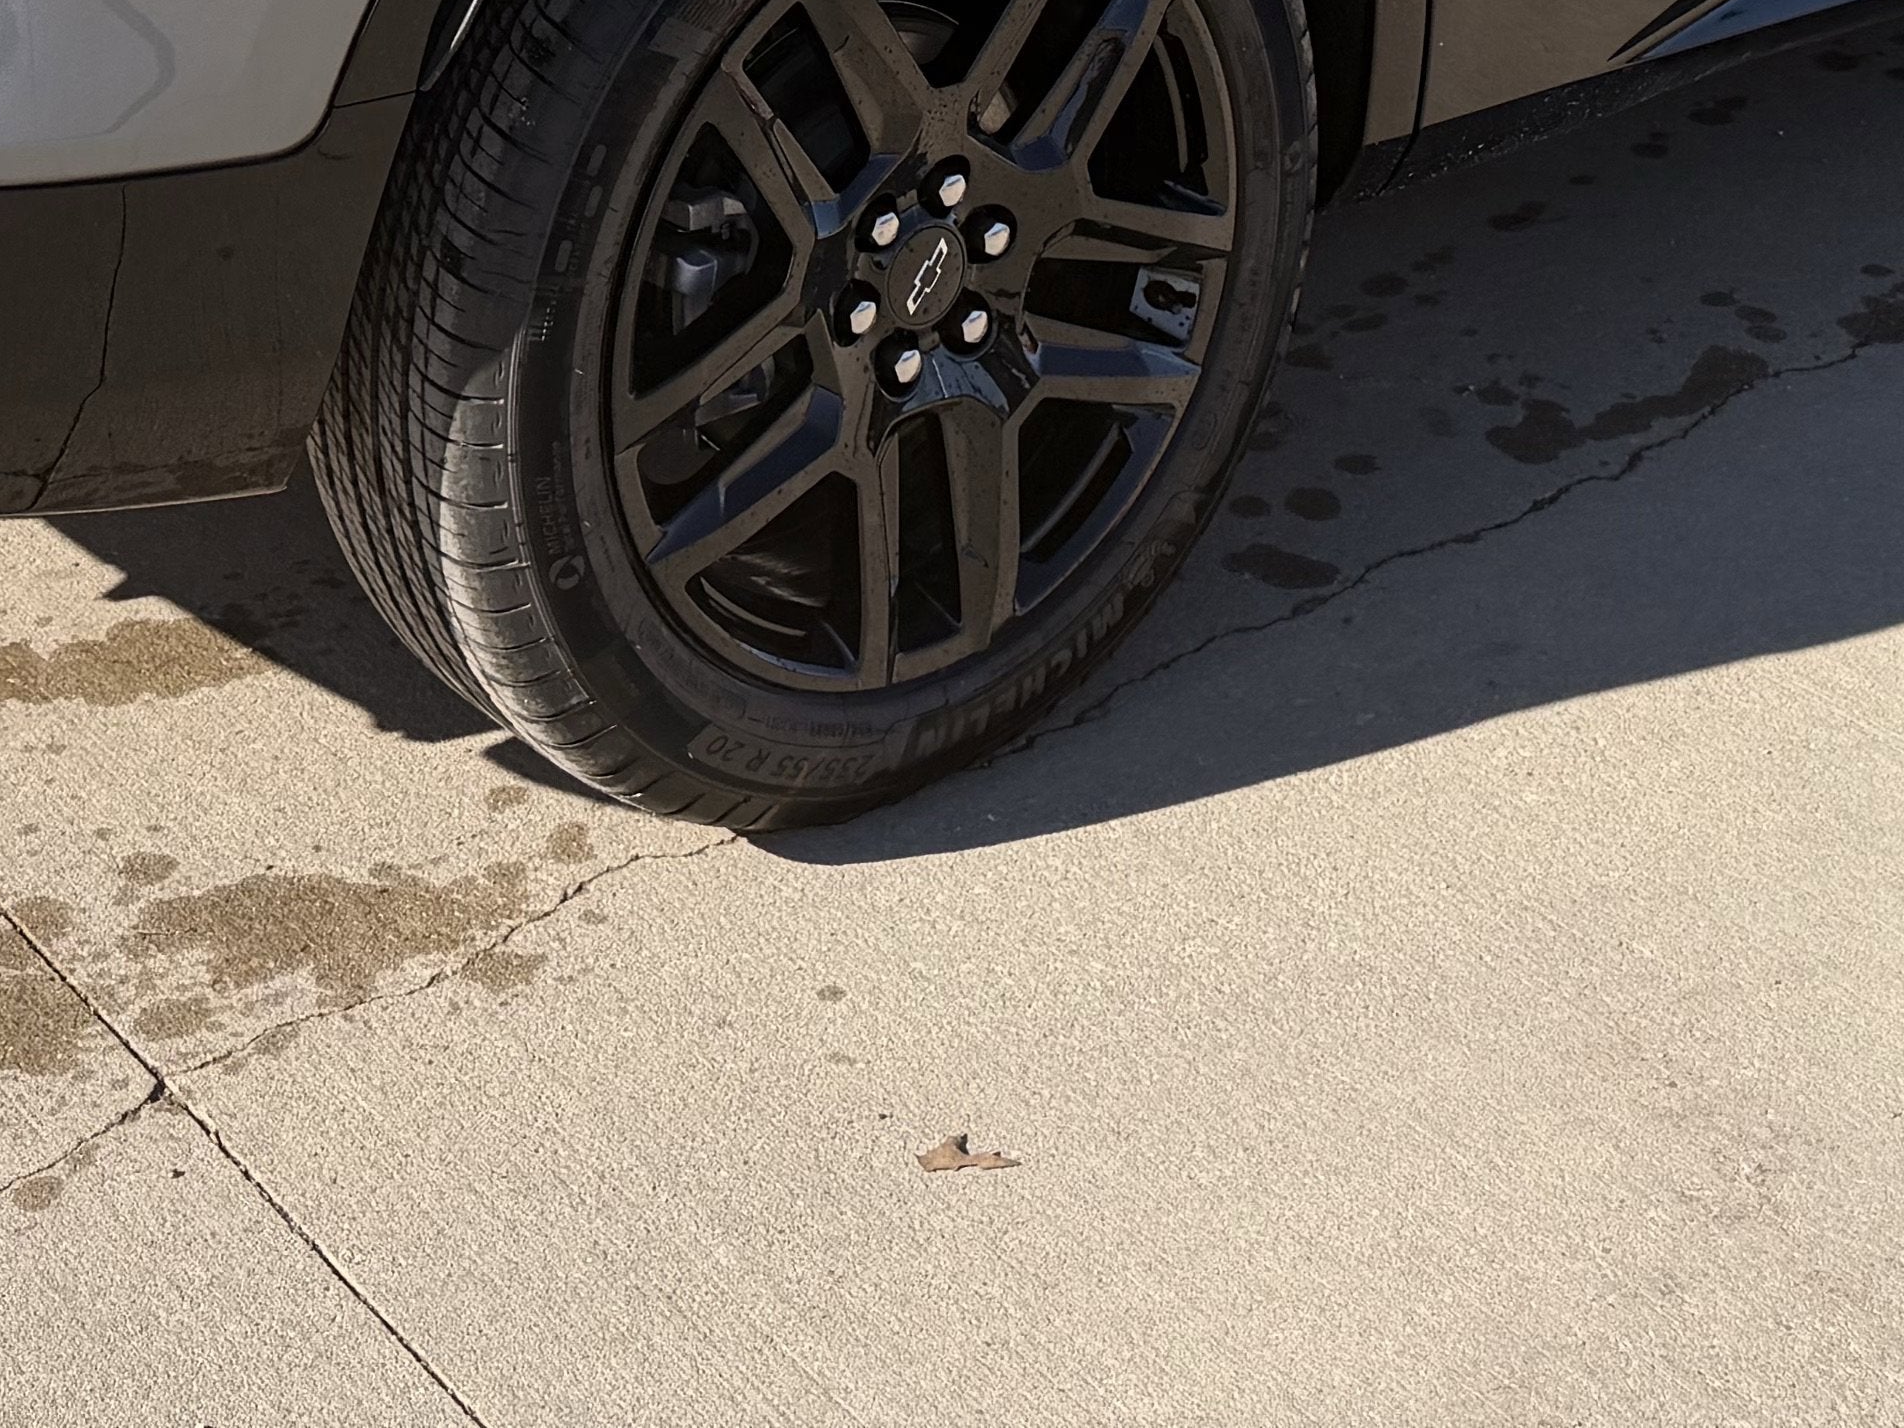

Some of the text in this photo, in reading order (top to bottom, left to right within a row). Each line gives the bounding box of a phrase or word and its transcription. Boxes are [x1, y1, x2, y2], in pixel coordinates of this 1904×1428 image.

[912, 593, 1125, 758] MICHELIN
[705, 734, 745, 762] 20
[744, 749, 771, 773] R
